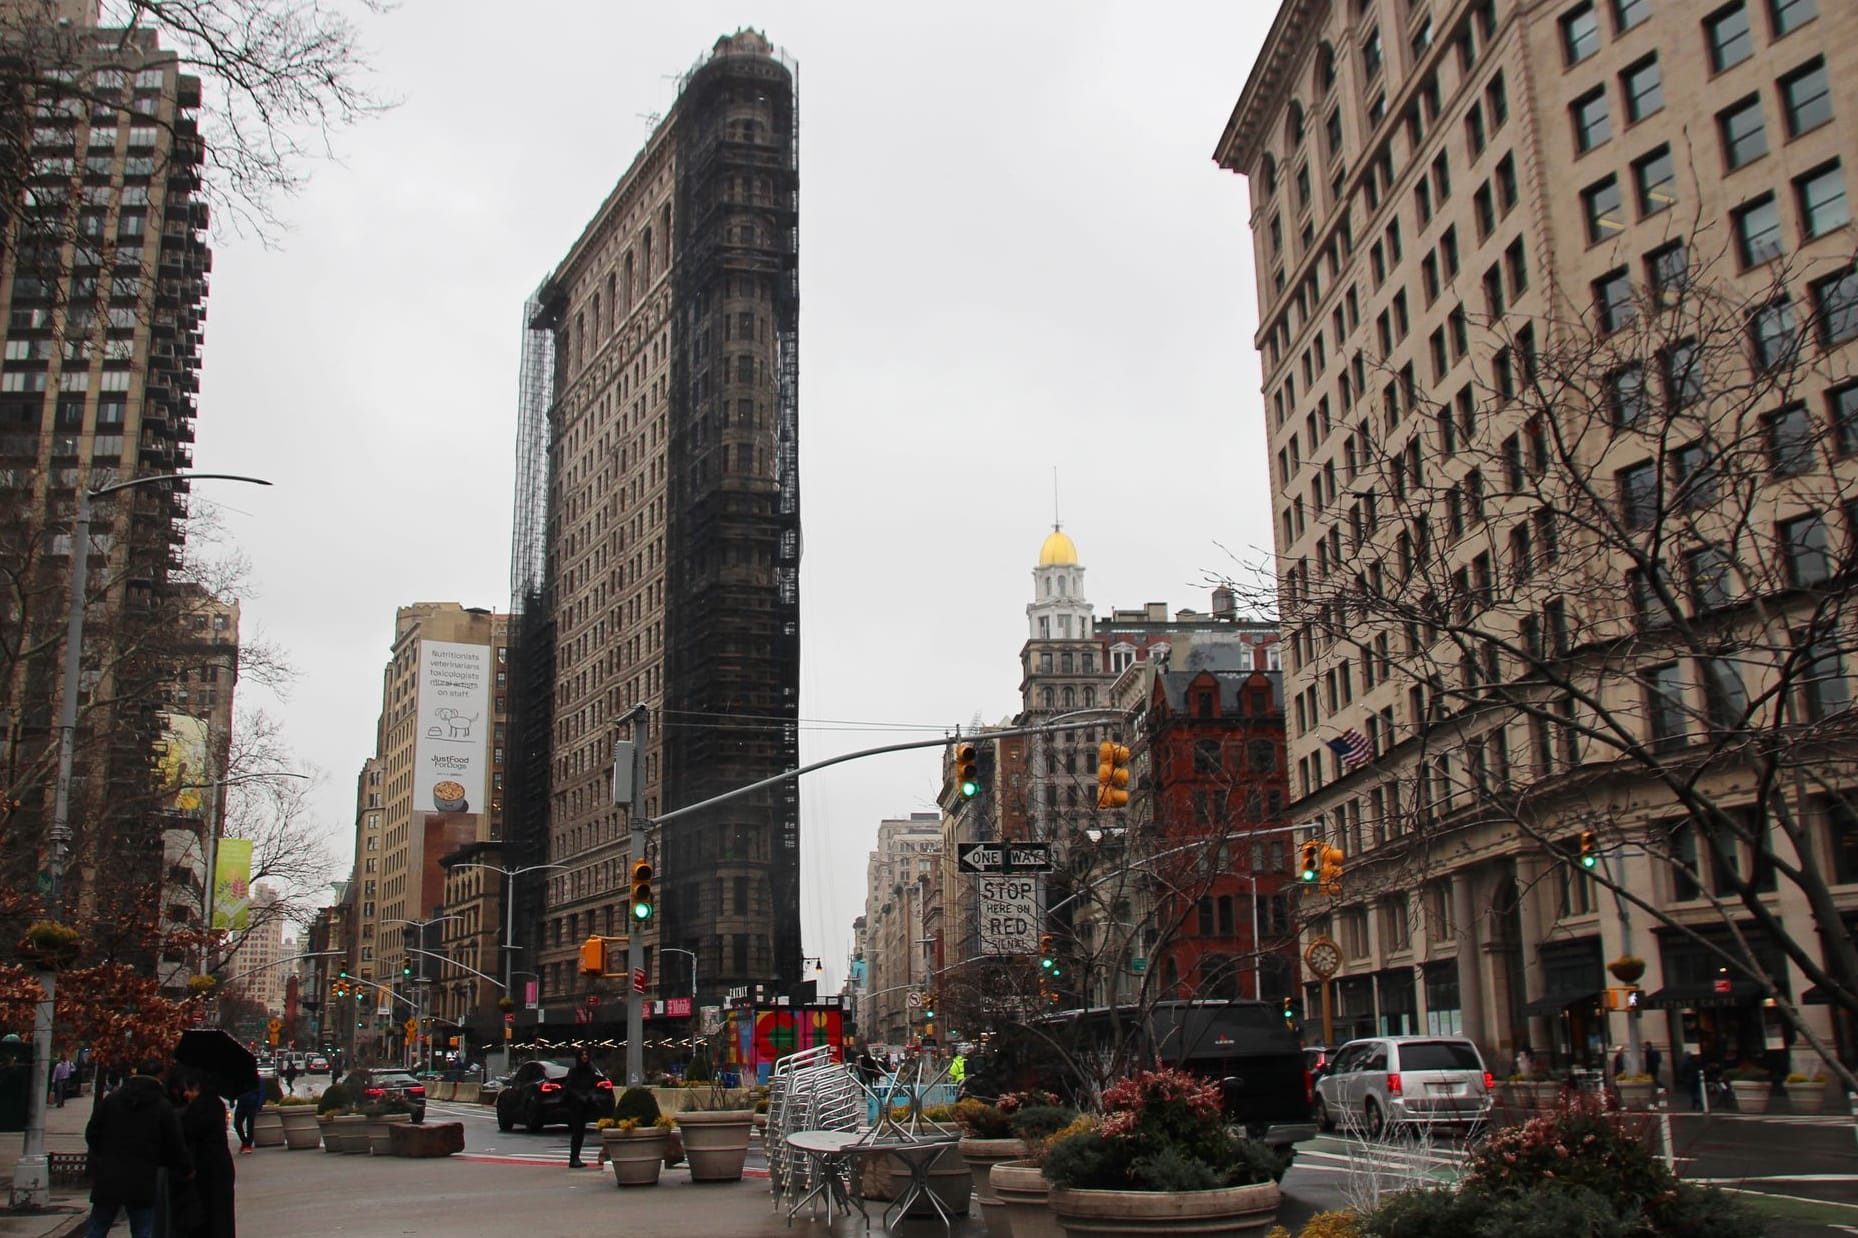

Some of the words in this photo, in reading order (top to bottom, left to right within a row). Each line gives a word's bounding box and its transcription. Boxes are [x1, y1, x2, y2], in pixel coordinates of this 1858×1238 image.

[431, 649, 480, 661] Nutritionists
[430, 660, 480, 670] veterinarians
[429, 670, 480, 680] toxicologists
[972, 851, 999, 864] ONE
[1011, 850, 1042, 864] WAY
[984, 882, 1032, 900] STOP
[986, 905, 1012, 914] HERE
[1016, 904, 1030, 914] ON
[990, 918, 1028, 935] RED
